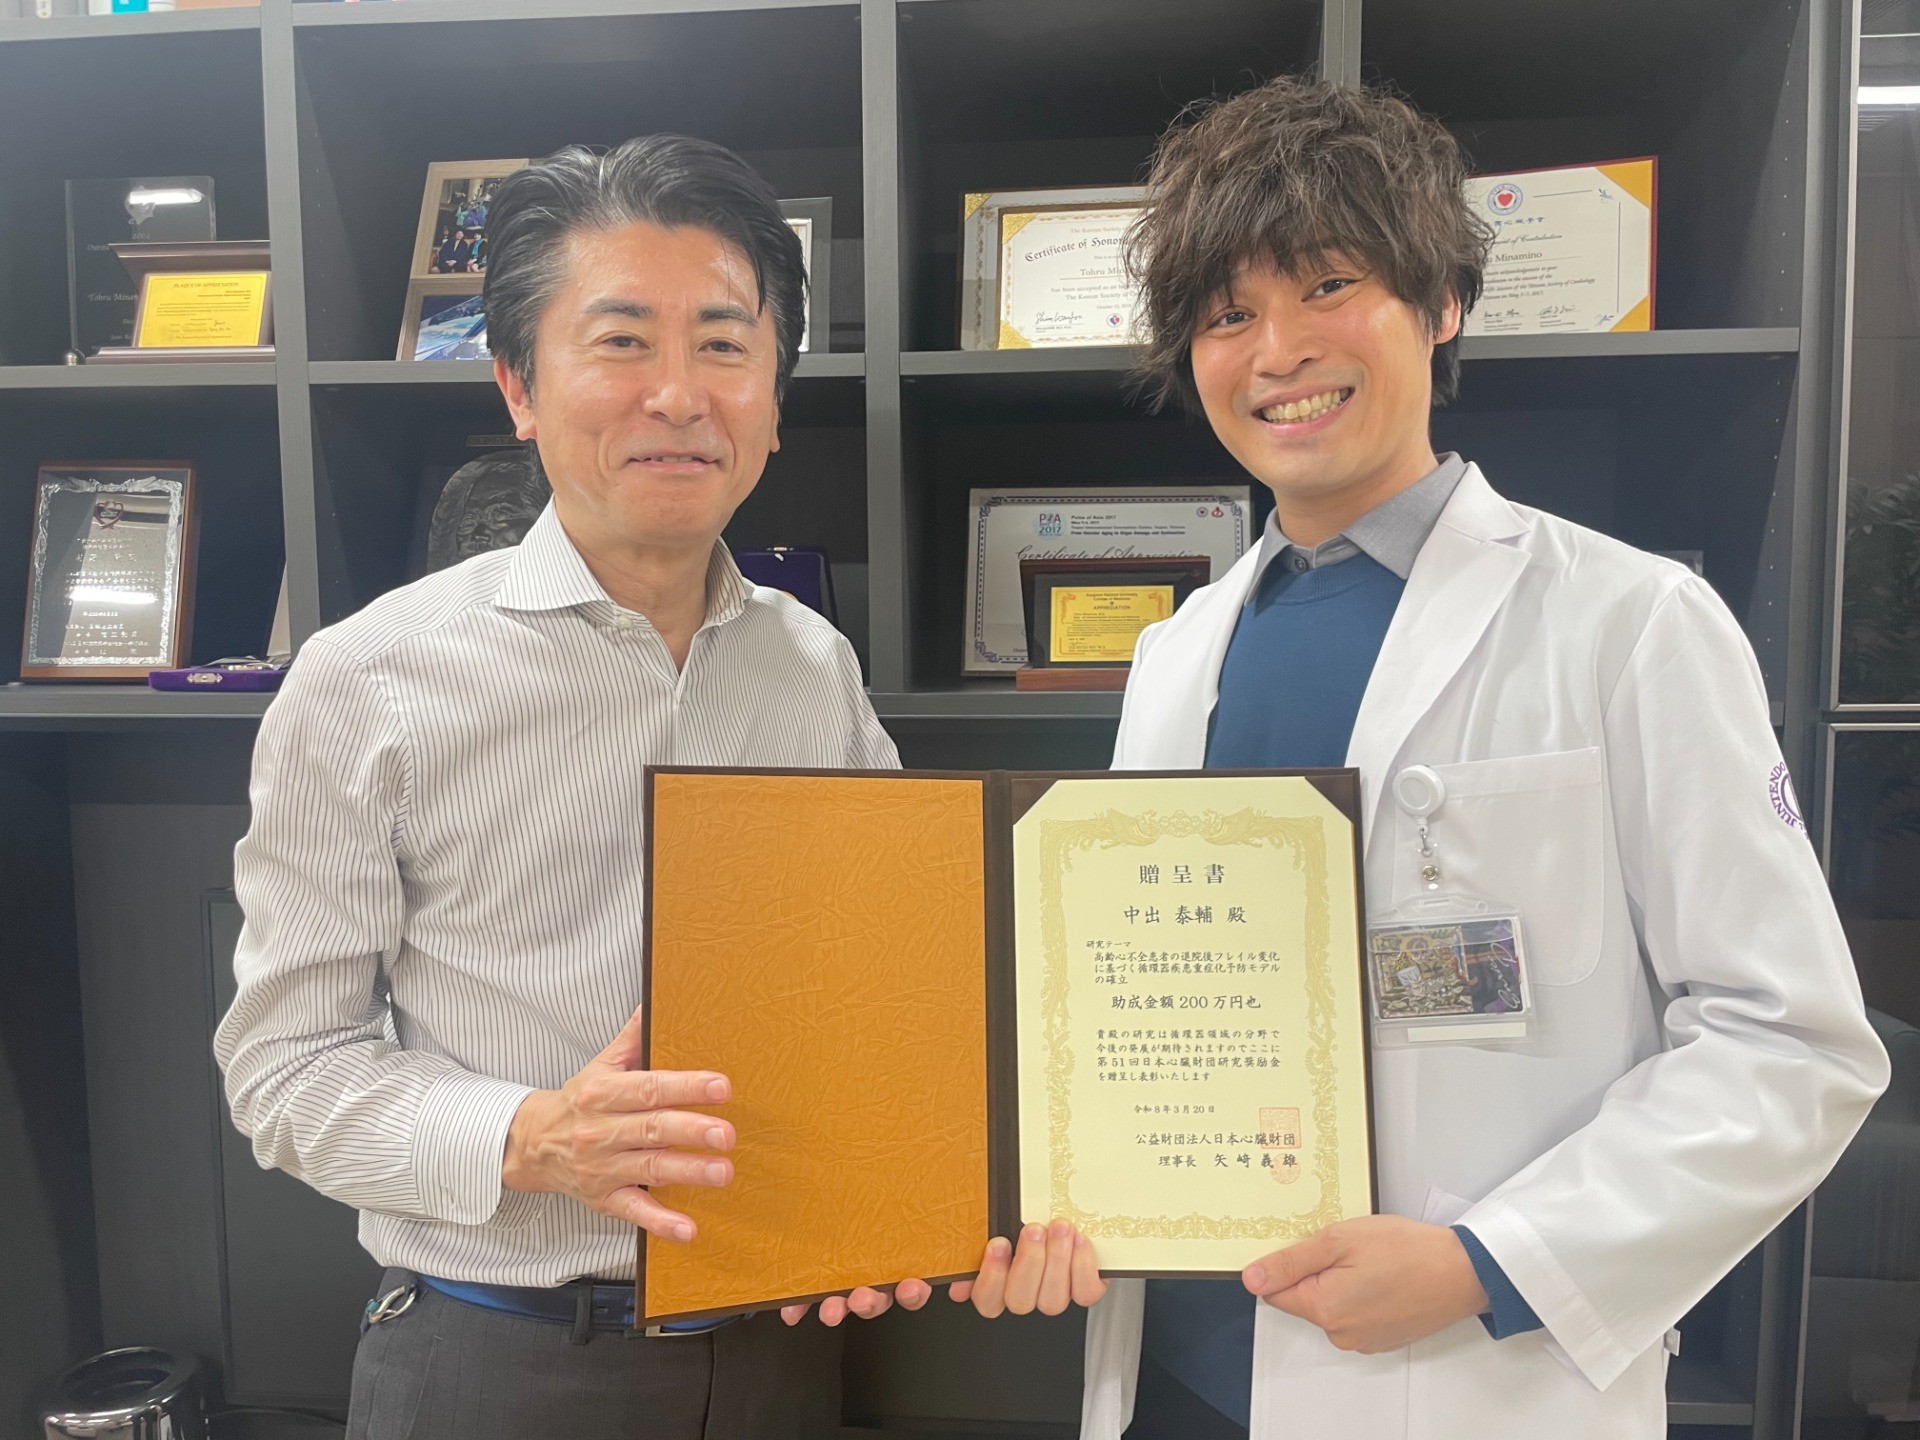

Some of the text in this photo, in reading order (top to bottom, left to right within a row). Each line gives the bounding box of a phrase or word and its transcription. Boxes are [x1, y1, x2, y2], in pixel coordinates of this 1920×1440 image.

[1025, 242, 1076, 262] Certificate
[1078, 238, 1088, 250] of
[1495, 251, 1543, 262] Minamino
[1080, 268, 1105, 276] Tohru
[1039, 526, 1061, 534] 2017
[1769, 761, 1797, 828] JUNTENDO
[1139, 864, 1225, 884] 贈呈書
[1124, 905, 1247, 924] 中出 泰輔 殿
[1086, 940, 1131, 948] 研究テーマ
[1095, 974, 1128, 984] の確立
[1158, 1155, 1197, 1166] 理事長
